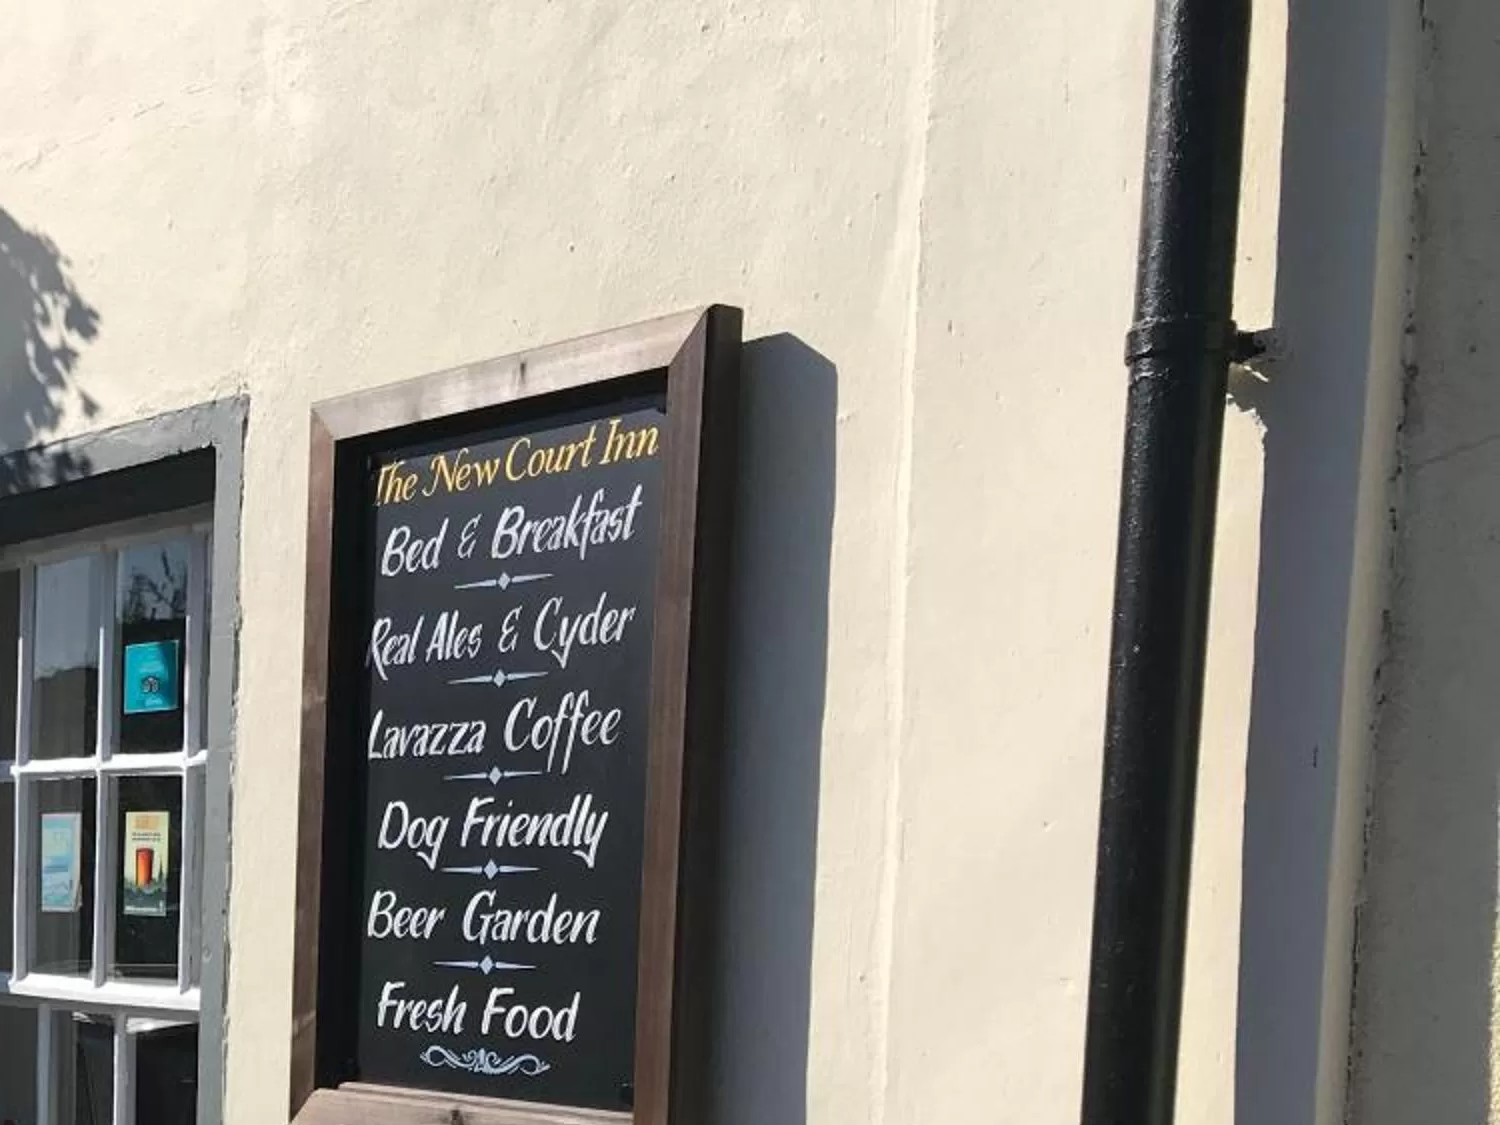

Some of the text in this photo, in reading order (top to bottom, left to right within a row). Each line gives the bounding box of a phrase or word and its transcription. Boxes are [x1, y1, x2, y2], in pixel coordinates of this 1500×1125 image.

[375, 418, 660, 507] The New Court Inn
[380, 483, 644, 578] Bed & Breakfast
[366, 591, 637, 681] Real Ales & Cyder
[367, 688, 623, 776] Lavazza Coffee
[377, 793, 610, 871] Dog Friendly
[366, 889, 601, 946] Beer Garden
[375, 981, 582, 1044] Fresh Food
